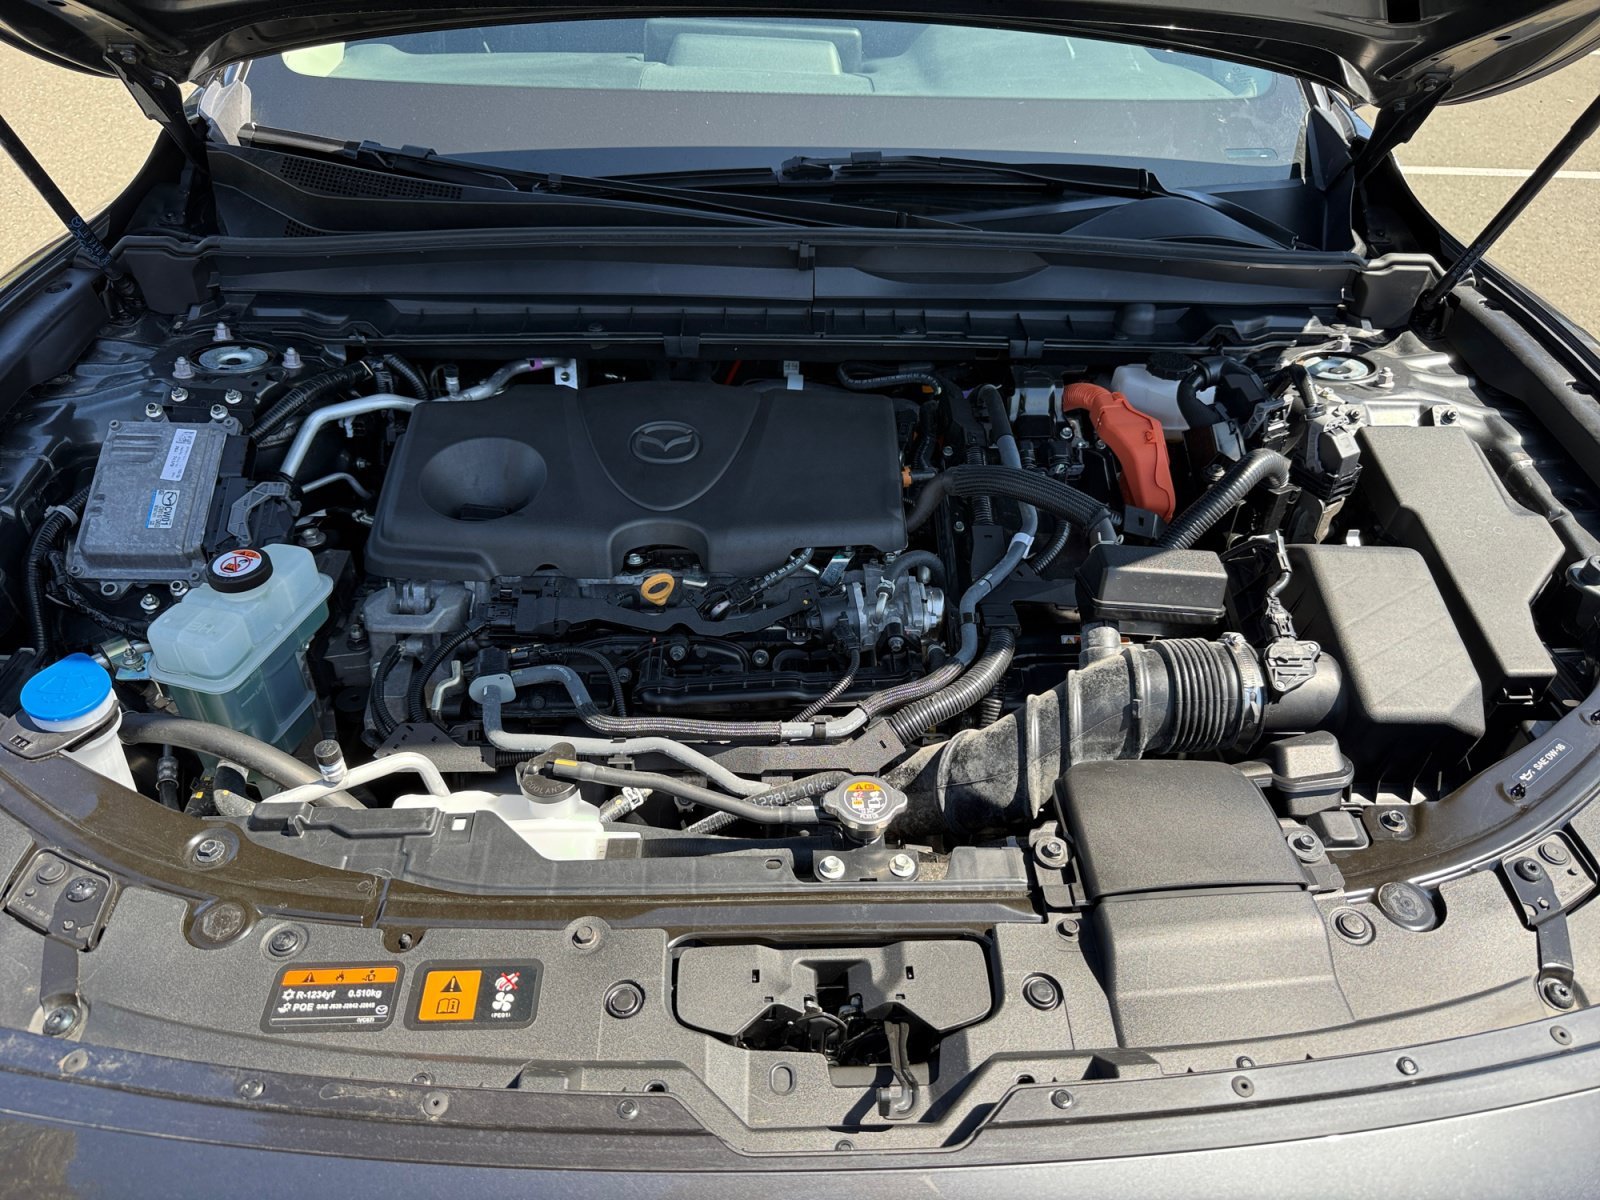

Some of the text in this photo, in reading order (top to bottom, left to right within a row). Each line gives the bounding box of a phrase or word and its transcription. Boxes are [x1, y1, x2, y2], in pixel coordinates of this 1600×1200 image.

[161, 506, 173, 526] CW01
[1533, 743, 1566, 771] SAE 0W-16
[525, 780, 565, 794] COOLANT
[296, 989, 383, 1001] R-1234yf 0.510kg
[292, 1002, 315, 1012] POE
